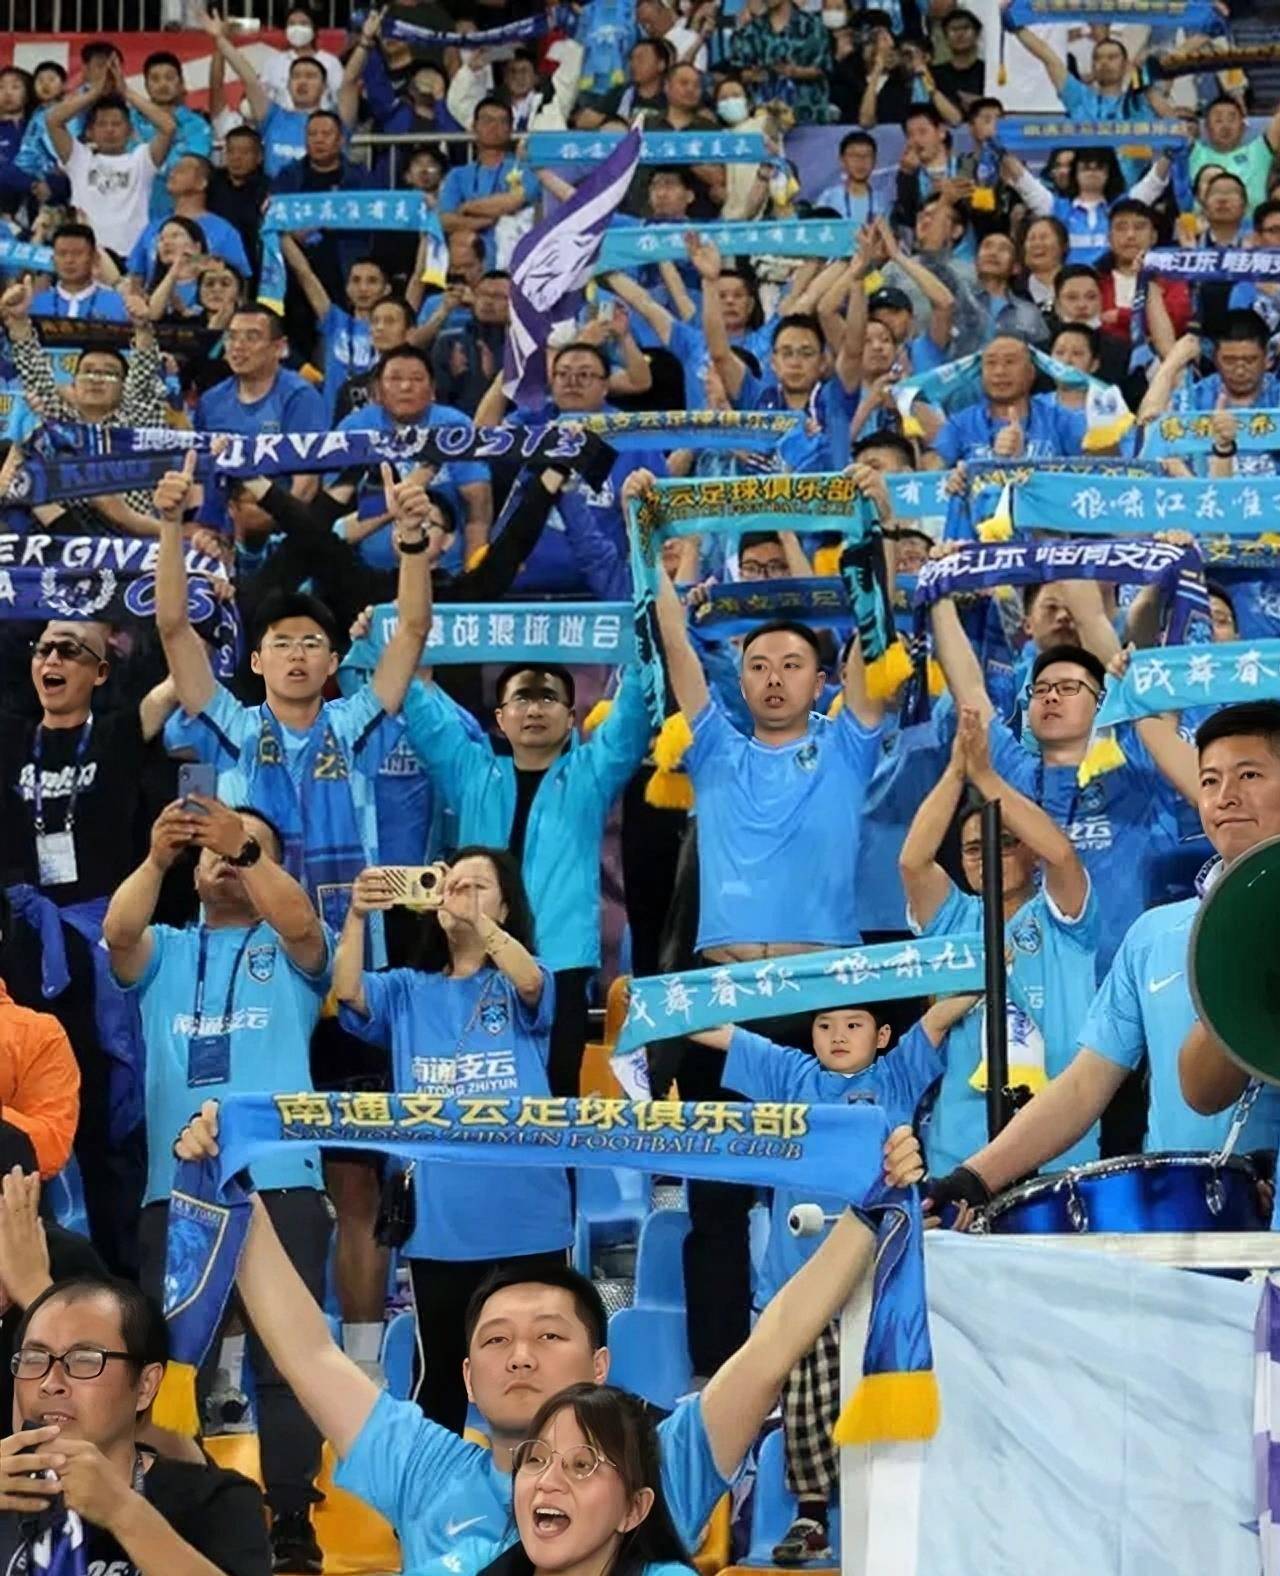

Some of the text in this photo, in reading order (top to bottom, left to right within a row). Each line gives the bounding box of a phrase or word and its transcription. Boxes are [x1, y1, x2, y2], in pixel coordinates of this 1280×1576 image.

[275, 1090, 811, 1141] 南通支云足球俱乐部
[569, 1132, 722, 1156] FOOTBALL
[727, 1137, 803, 1161] CLUB
